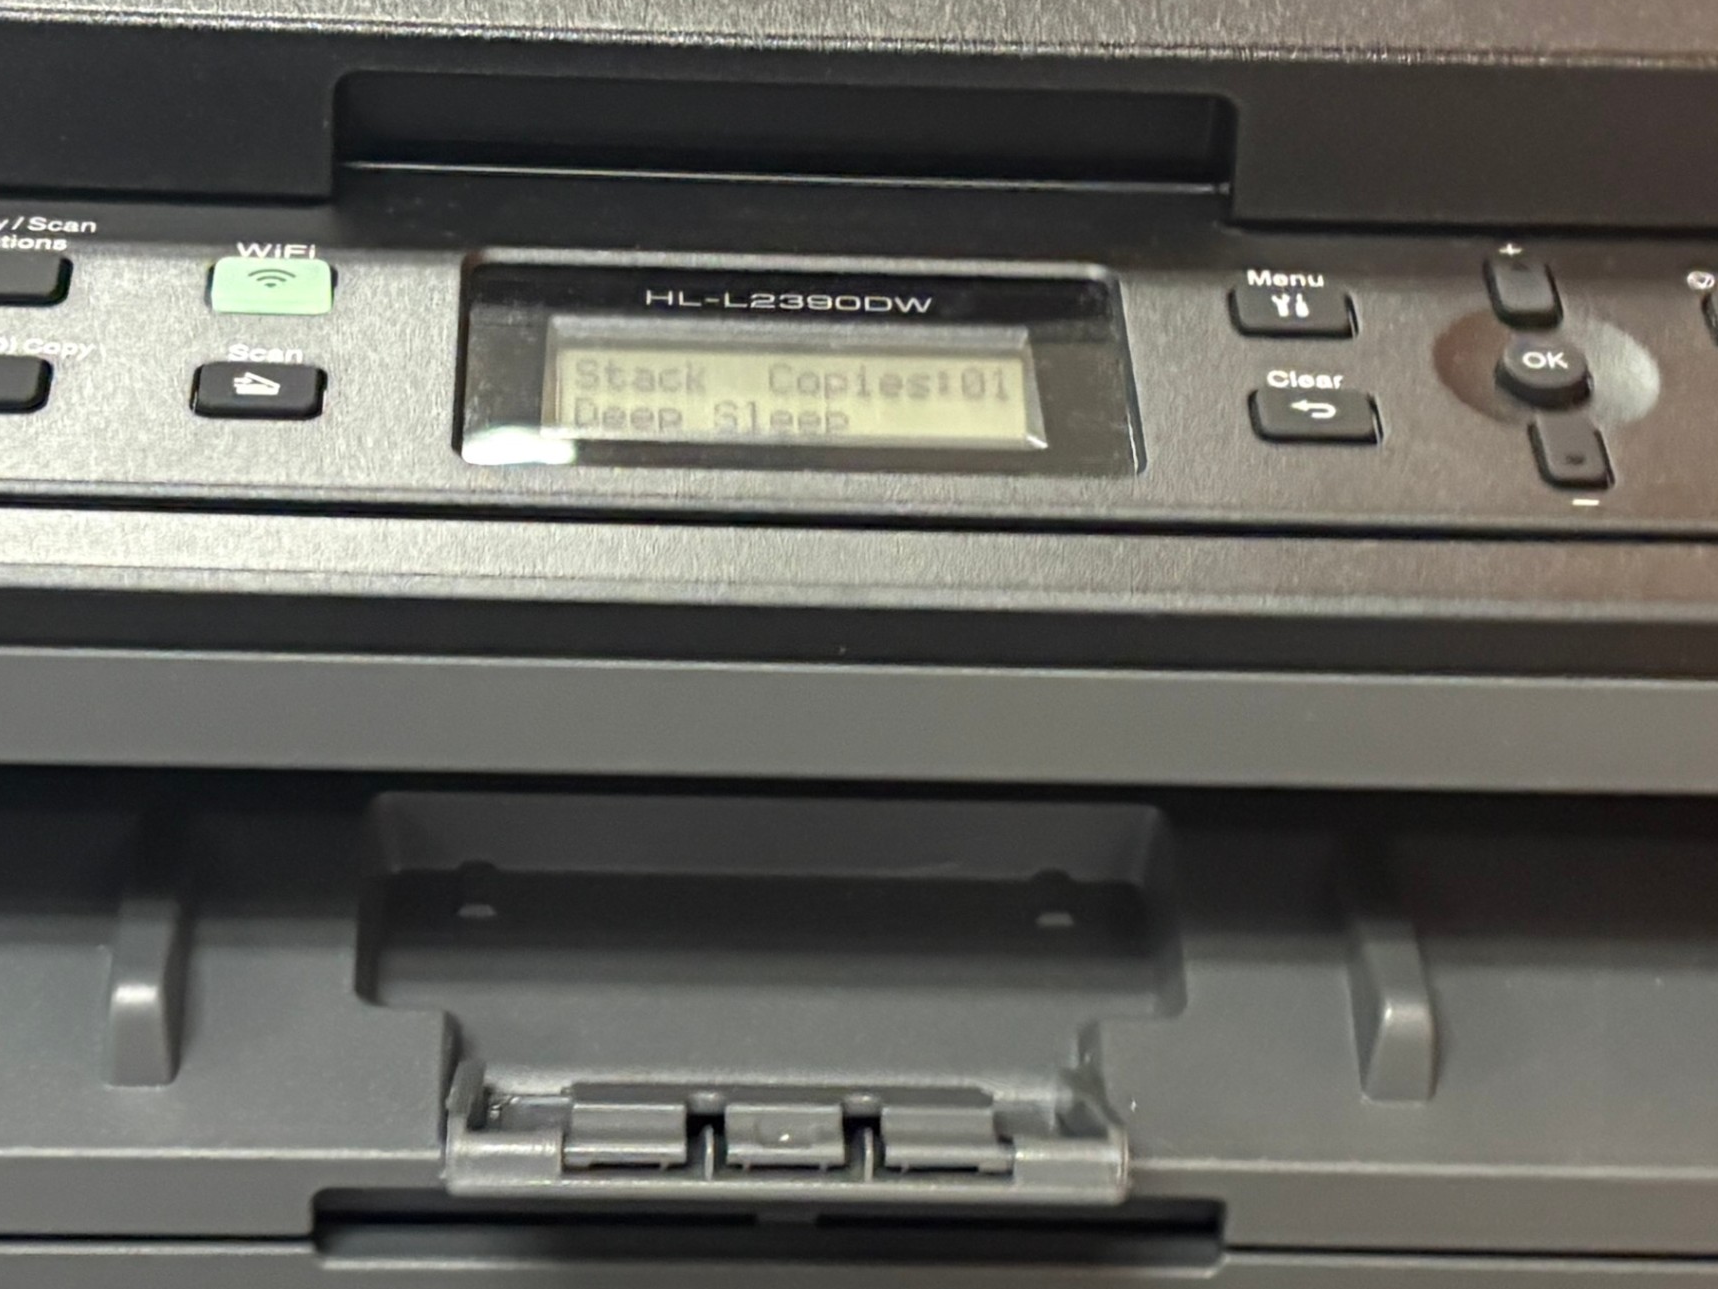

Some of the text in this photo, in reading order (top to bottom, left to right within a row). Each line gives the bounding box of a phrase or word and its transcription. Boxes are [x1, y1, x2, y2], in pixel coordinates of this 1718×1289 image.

[27, 216, 97, 234] Scan
[236, 241, 317, 260] WiFi
[1246, 269, 1325, 289] Menu
[645, 289, 933, 313] HL-L2390DW
[22, 337, 96, 360] Copy
[228, 343, 304, 363] Scan
[1522, 351, 1568, 370] OK
[573, 358, 1011, 402] Stack Copies:01
[1266, 369, 1345, 390] Clear
[572, 396, 851, 434] Deep Sleep
